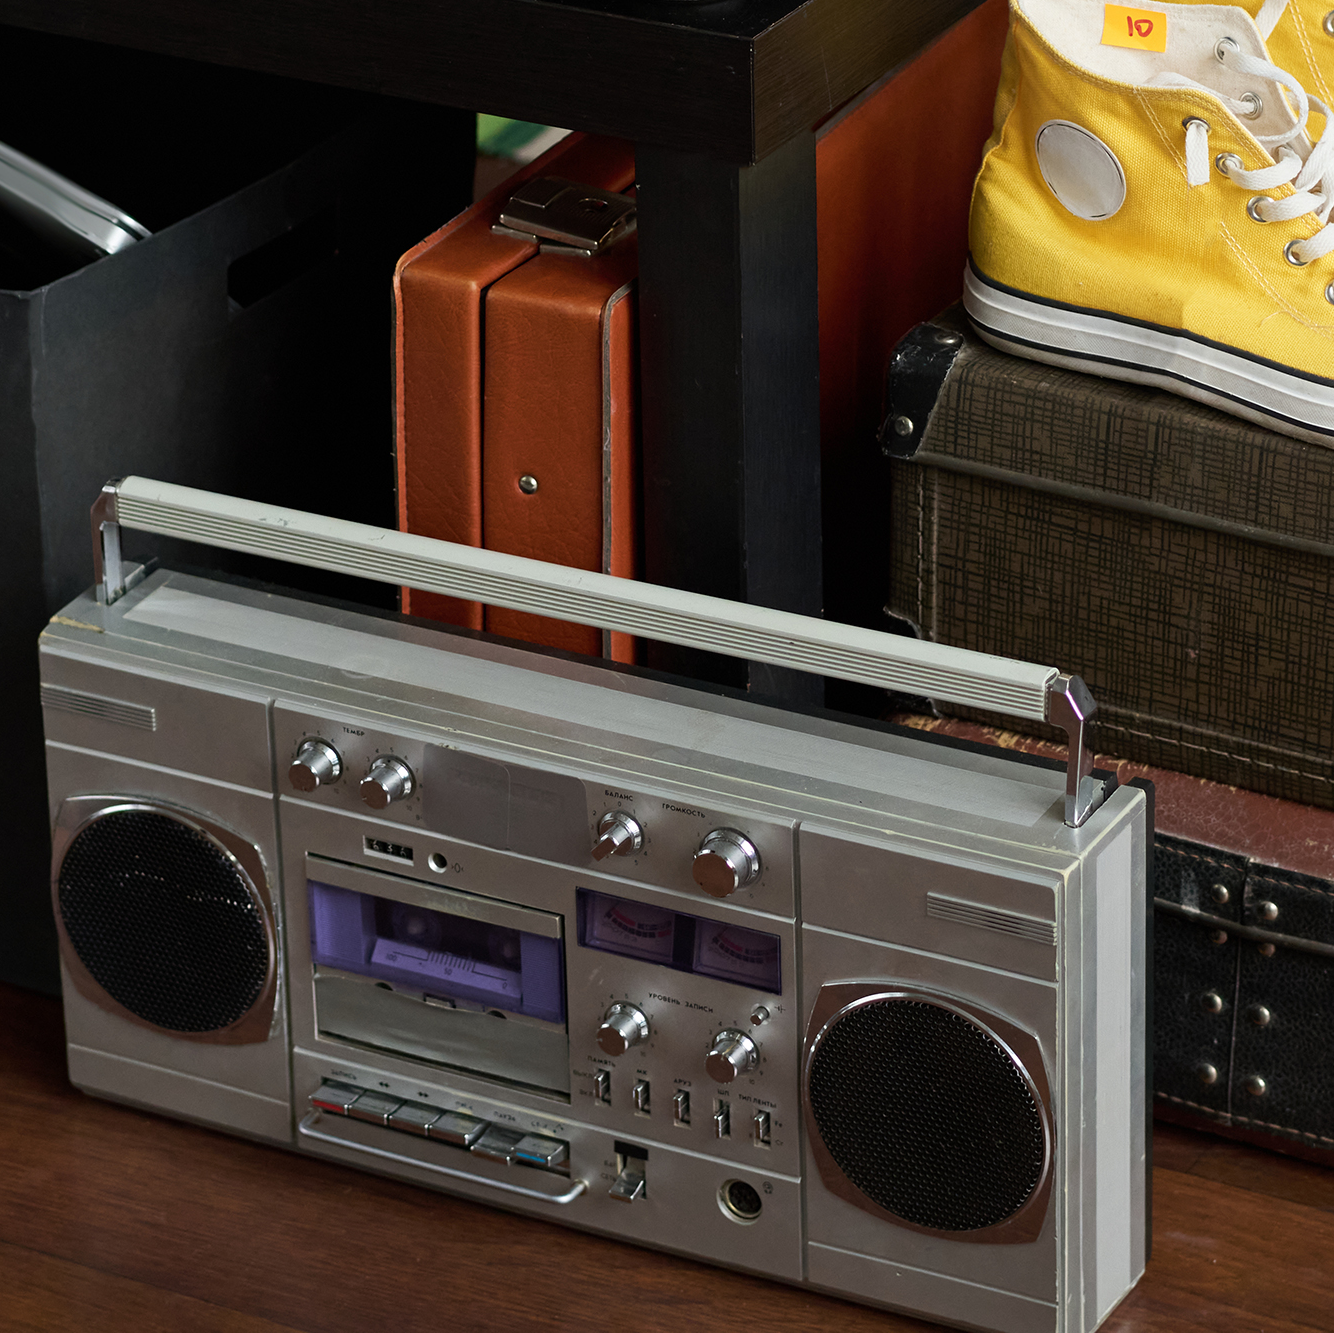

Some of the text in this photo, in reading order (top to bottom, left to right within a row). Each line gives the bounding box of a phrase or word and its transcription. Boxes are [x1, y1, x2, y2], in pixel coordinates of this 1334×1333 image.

[1127, 16, 1153, 38] 10
[342, 726, 365, 737] ТЕМБР
[604, 790, 634, 802] БАЛАНС
[662, 802, 706, 818] ГРОМКОСТЬ
[649, 992, 714, 1014] УРОВЕНЬ ЗАПИСИ
[588, 1055, 616, 1067] ПАМЯТЬ
[673, 1078, 692, 1087] АРУЗ
[738, 1094, 777, 1108] ТИП ЛЕНТЫ
